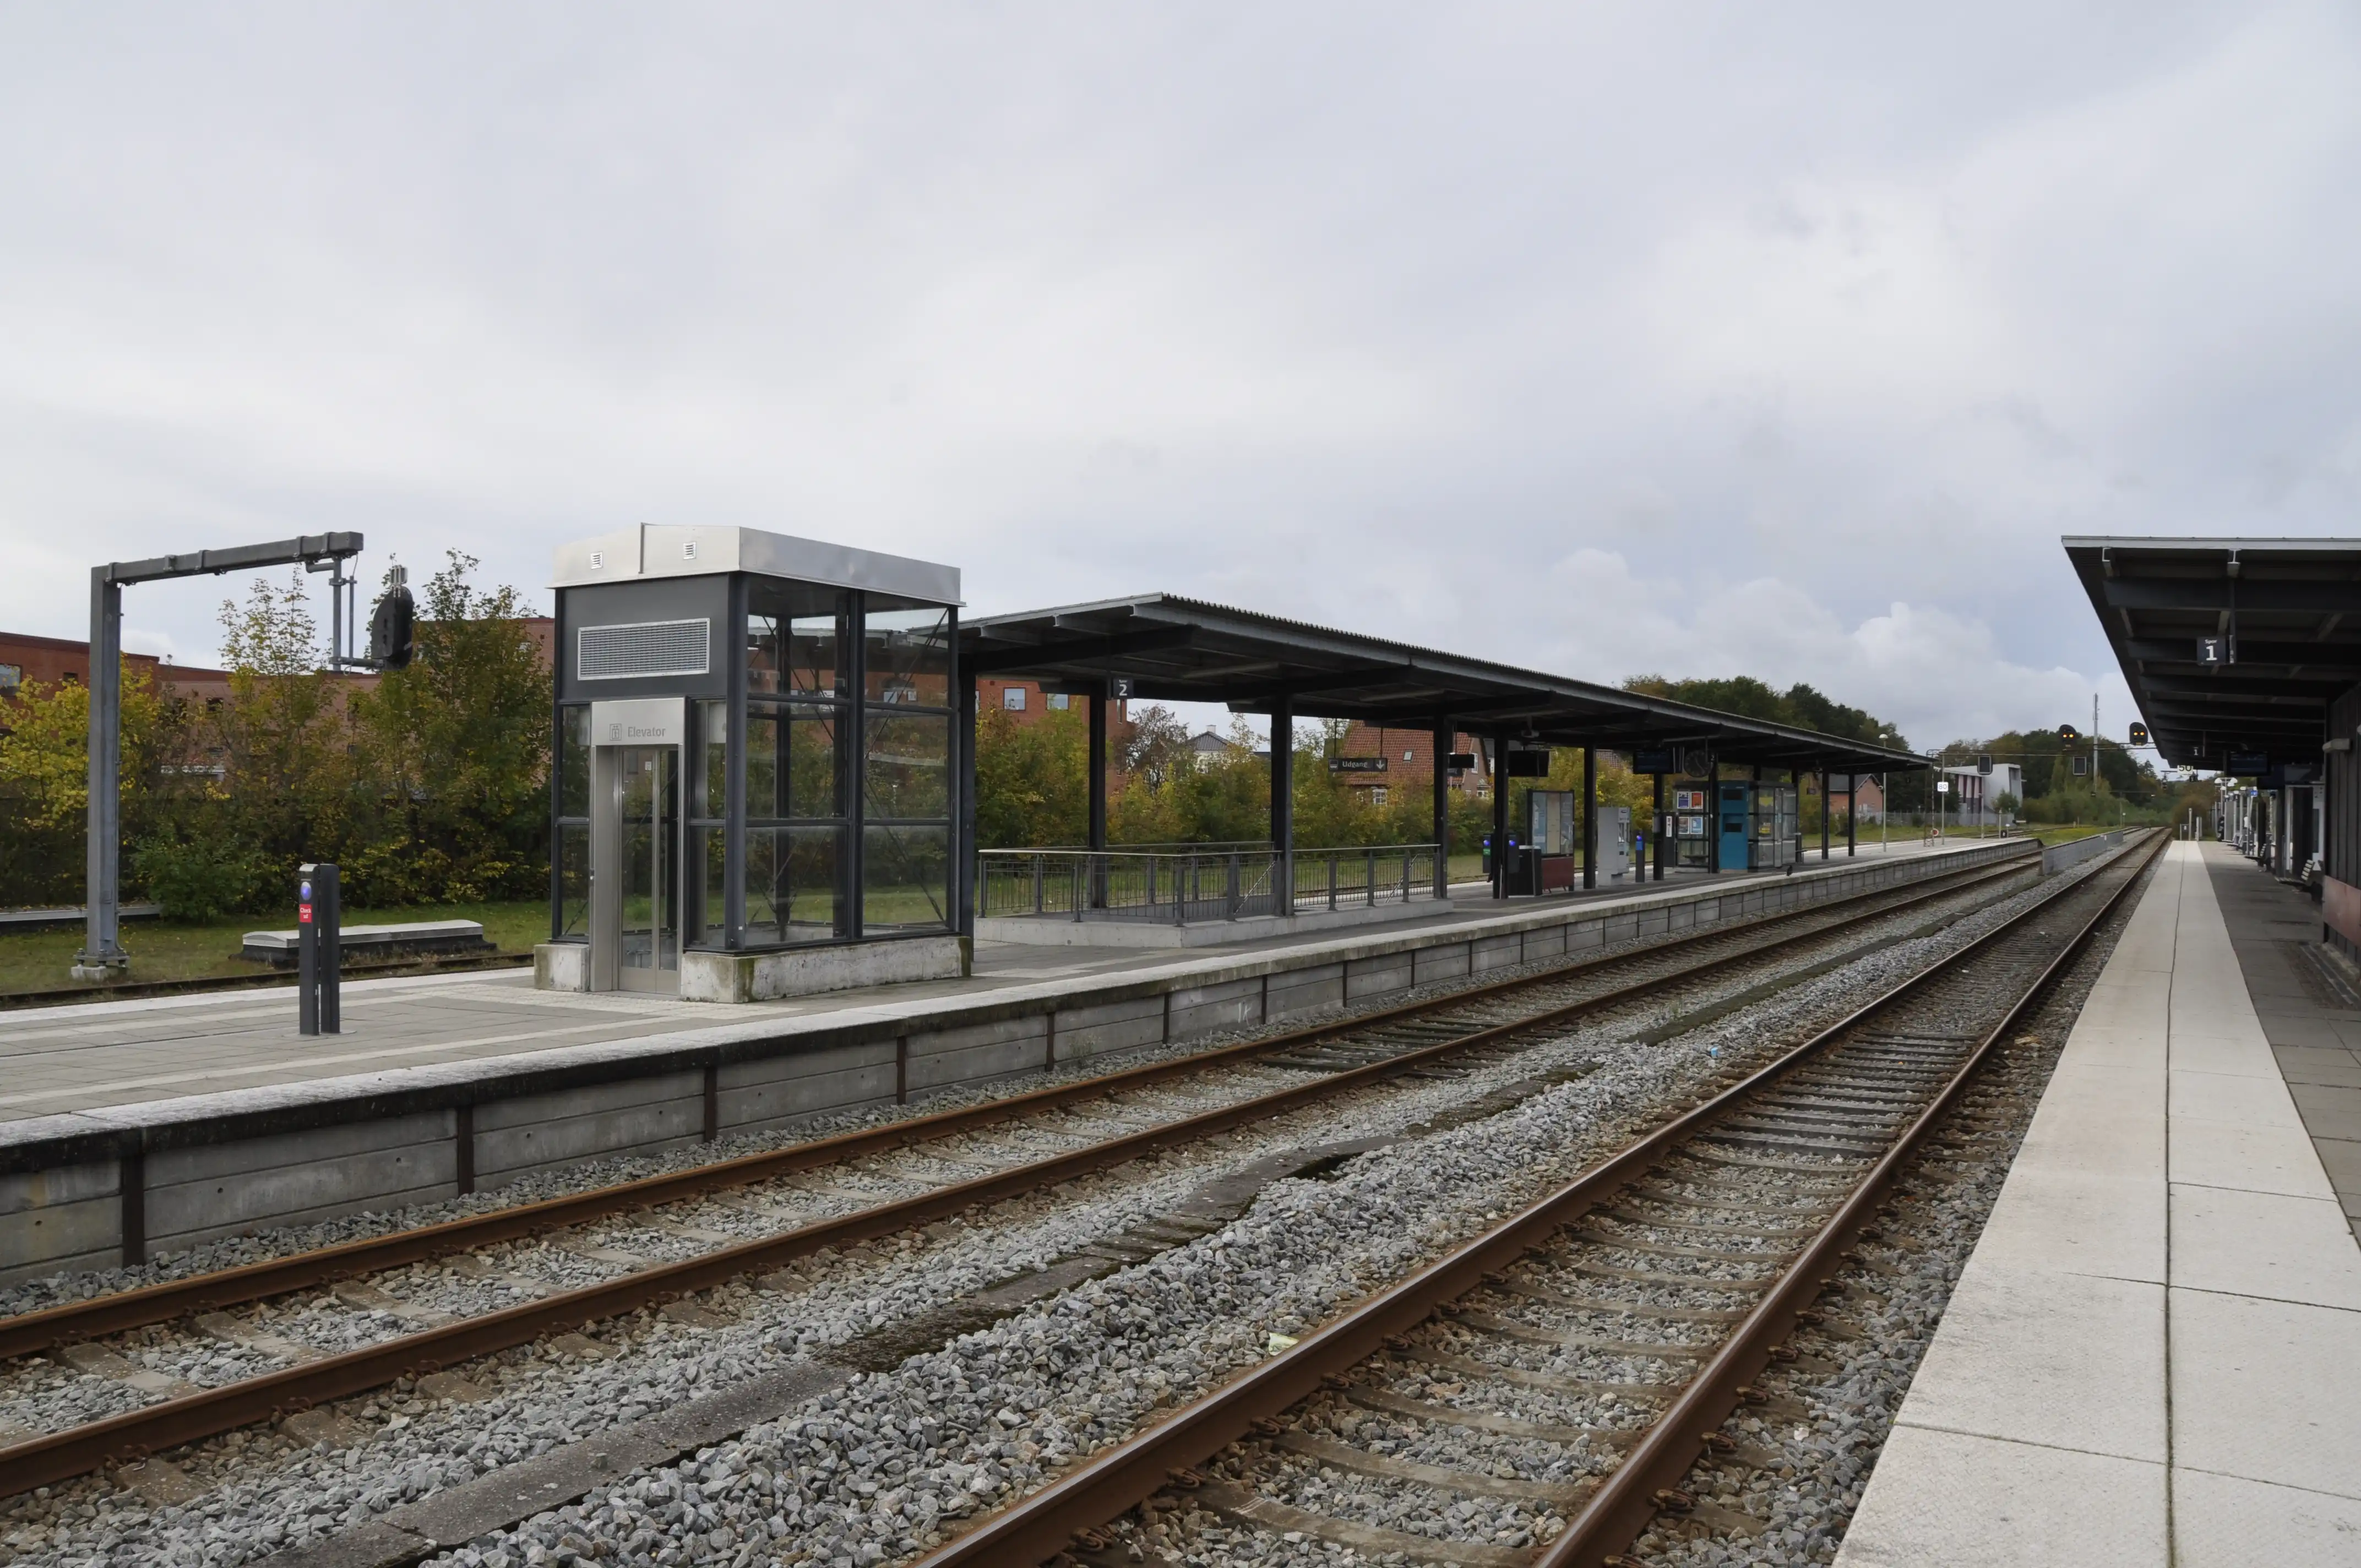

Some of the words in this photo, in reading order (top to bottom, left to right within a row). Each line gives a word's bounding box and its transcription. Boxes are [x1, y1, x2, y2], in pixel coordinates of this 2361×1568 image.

[2206, 645, 2217, 661] 1
[1119, 684, 1127, 696] 2
[628, 726, 666, 738] Elevator
